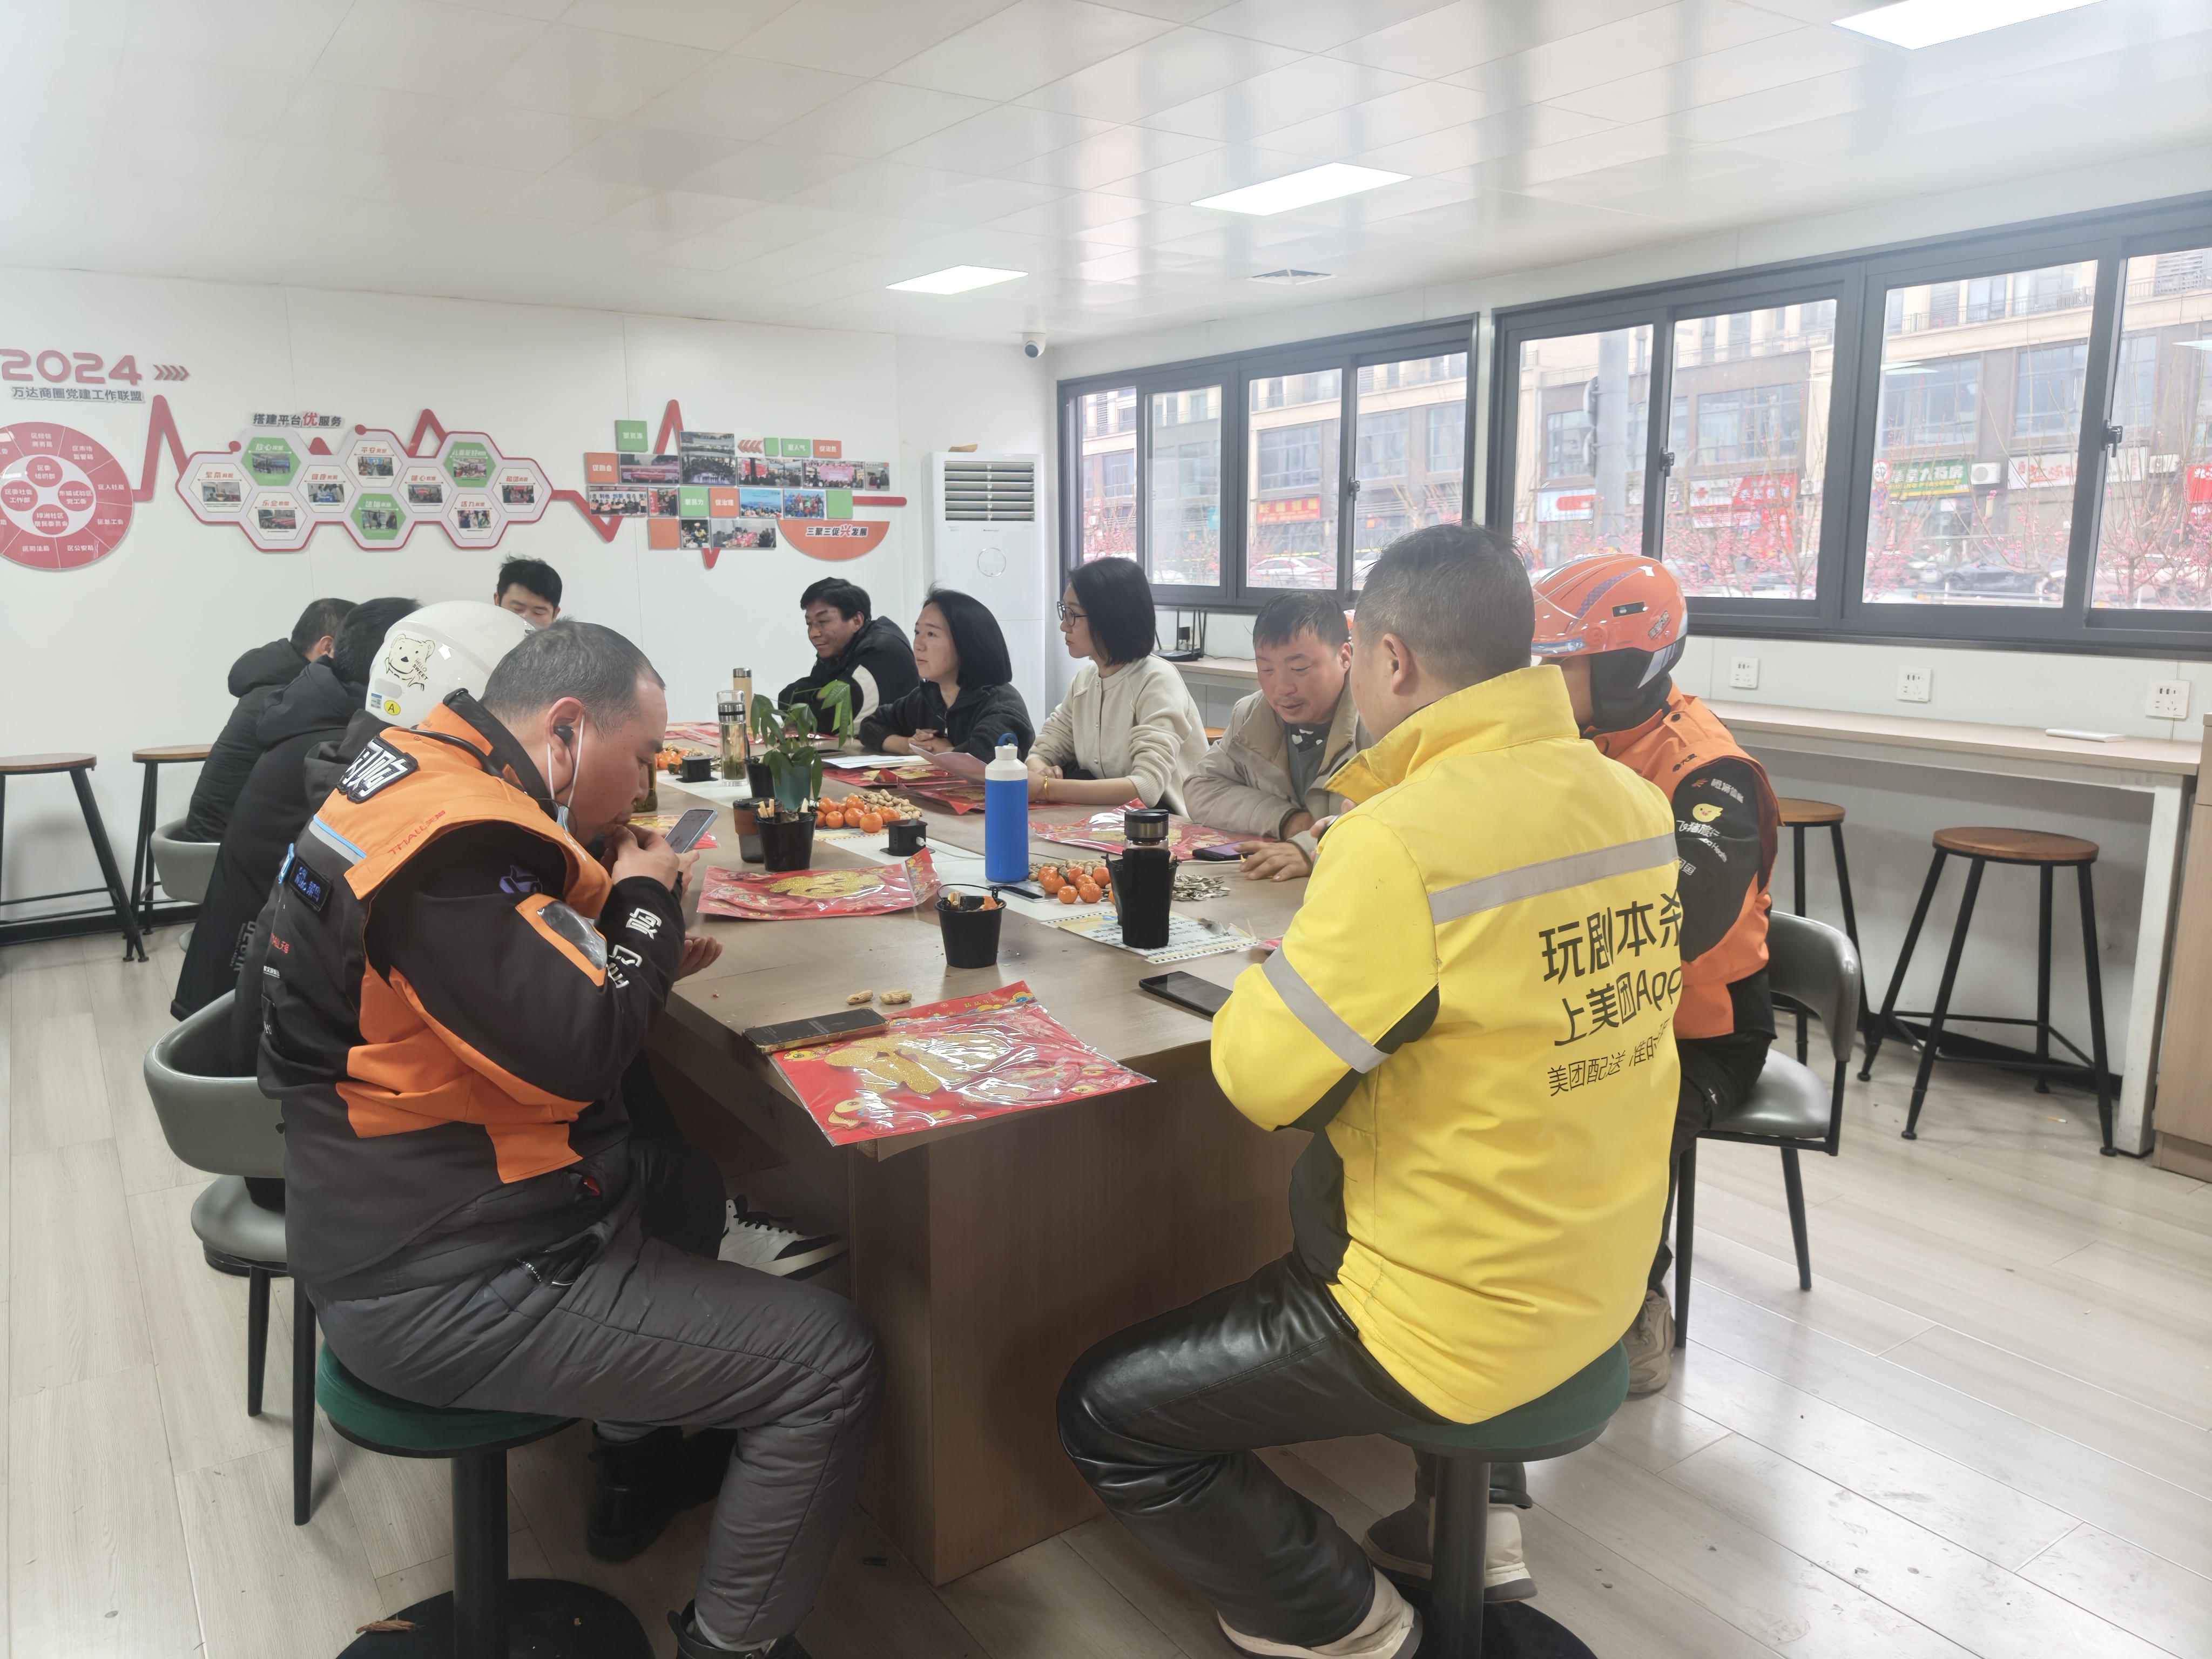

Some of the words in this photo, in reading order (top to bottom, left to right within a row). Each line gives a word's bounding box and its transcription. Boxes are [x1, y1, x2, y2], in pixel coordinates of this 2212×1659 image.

[0, 349, 142, 386] 2024
[12, 387, 143, 402] 万达商圈党建工作联盟
[253, 412, 342, 427] 搭建平台优服务
[806, 523, 868, 536] 三聚三促兴发展
[413, 664, 429, 680] SWEET
[414, 658, 427, 672] HELLO
[388, 703, 395, 713] A
[1676, 820, 1721, 838] 飞猪旅行
[1538, 889, 1682, 986] 玩剧本杀
[1547, 1050, 1626, 1097] 美团配送
